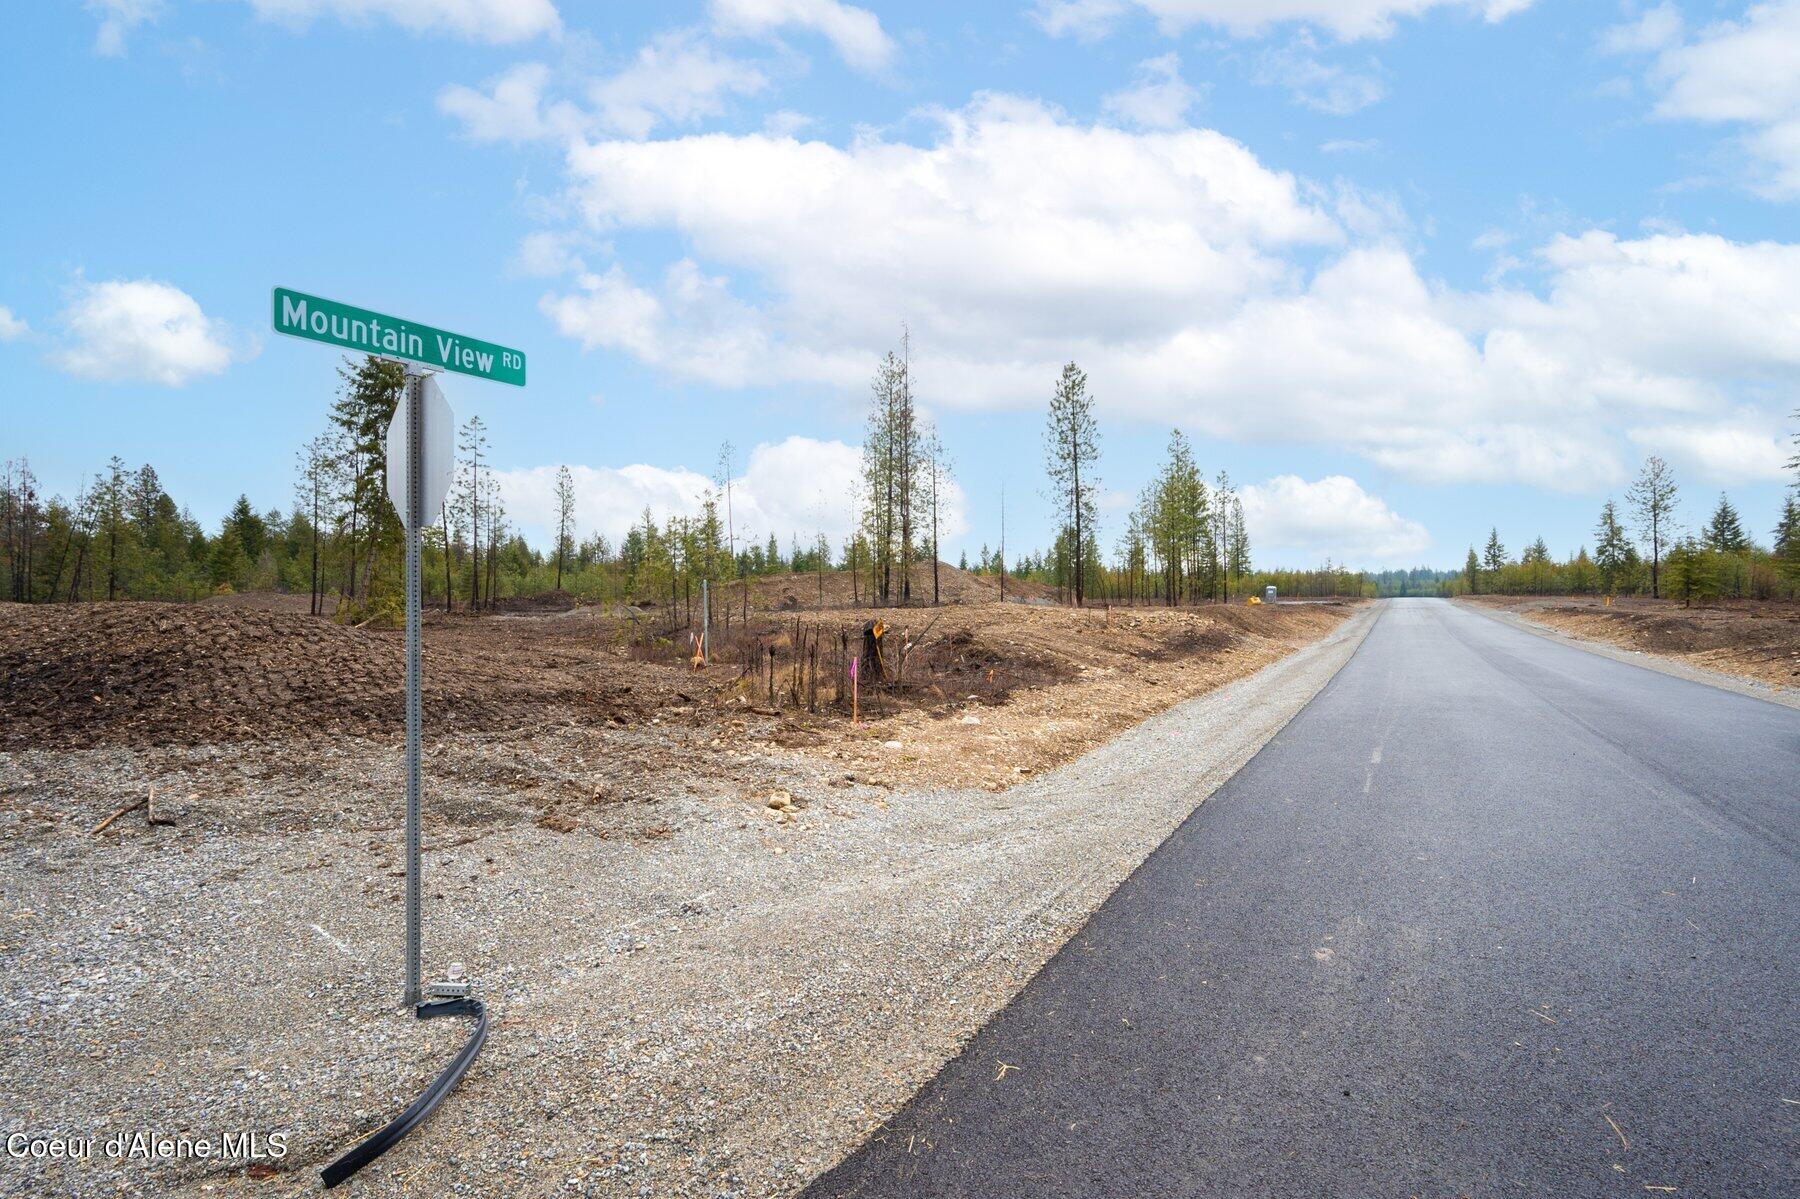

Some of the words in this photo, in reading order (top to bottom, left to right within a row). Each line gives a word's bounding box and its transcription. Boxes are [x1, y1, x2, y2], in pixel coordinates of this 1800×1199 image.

[282, 296, 423, 357] Mountain
[436, 335, 494, 373] View
[502, 352, 522, 370] RD
